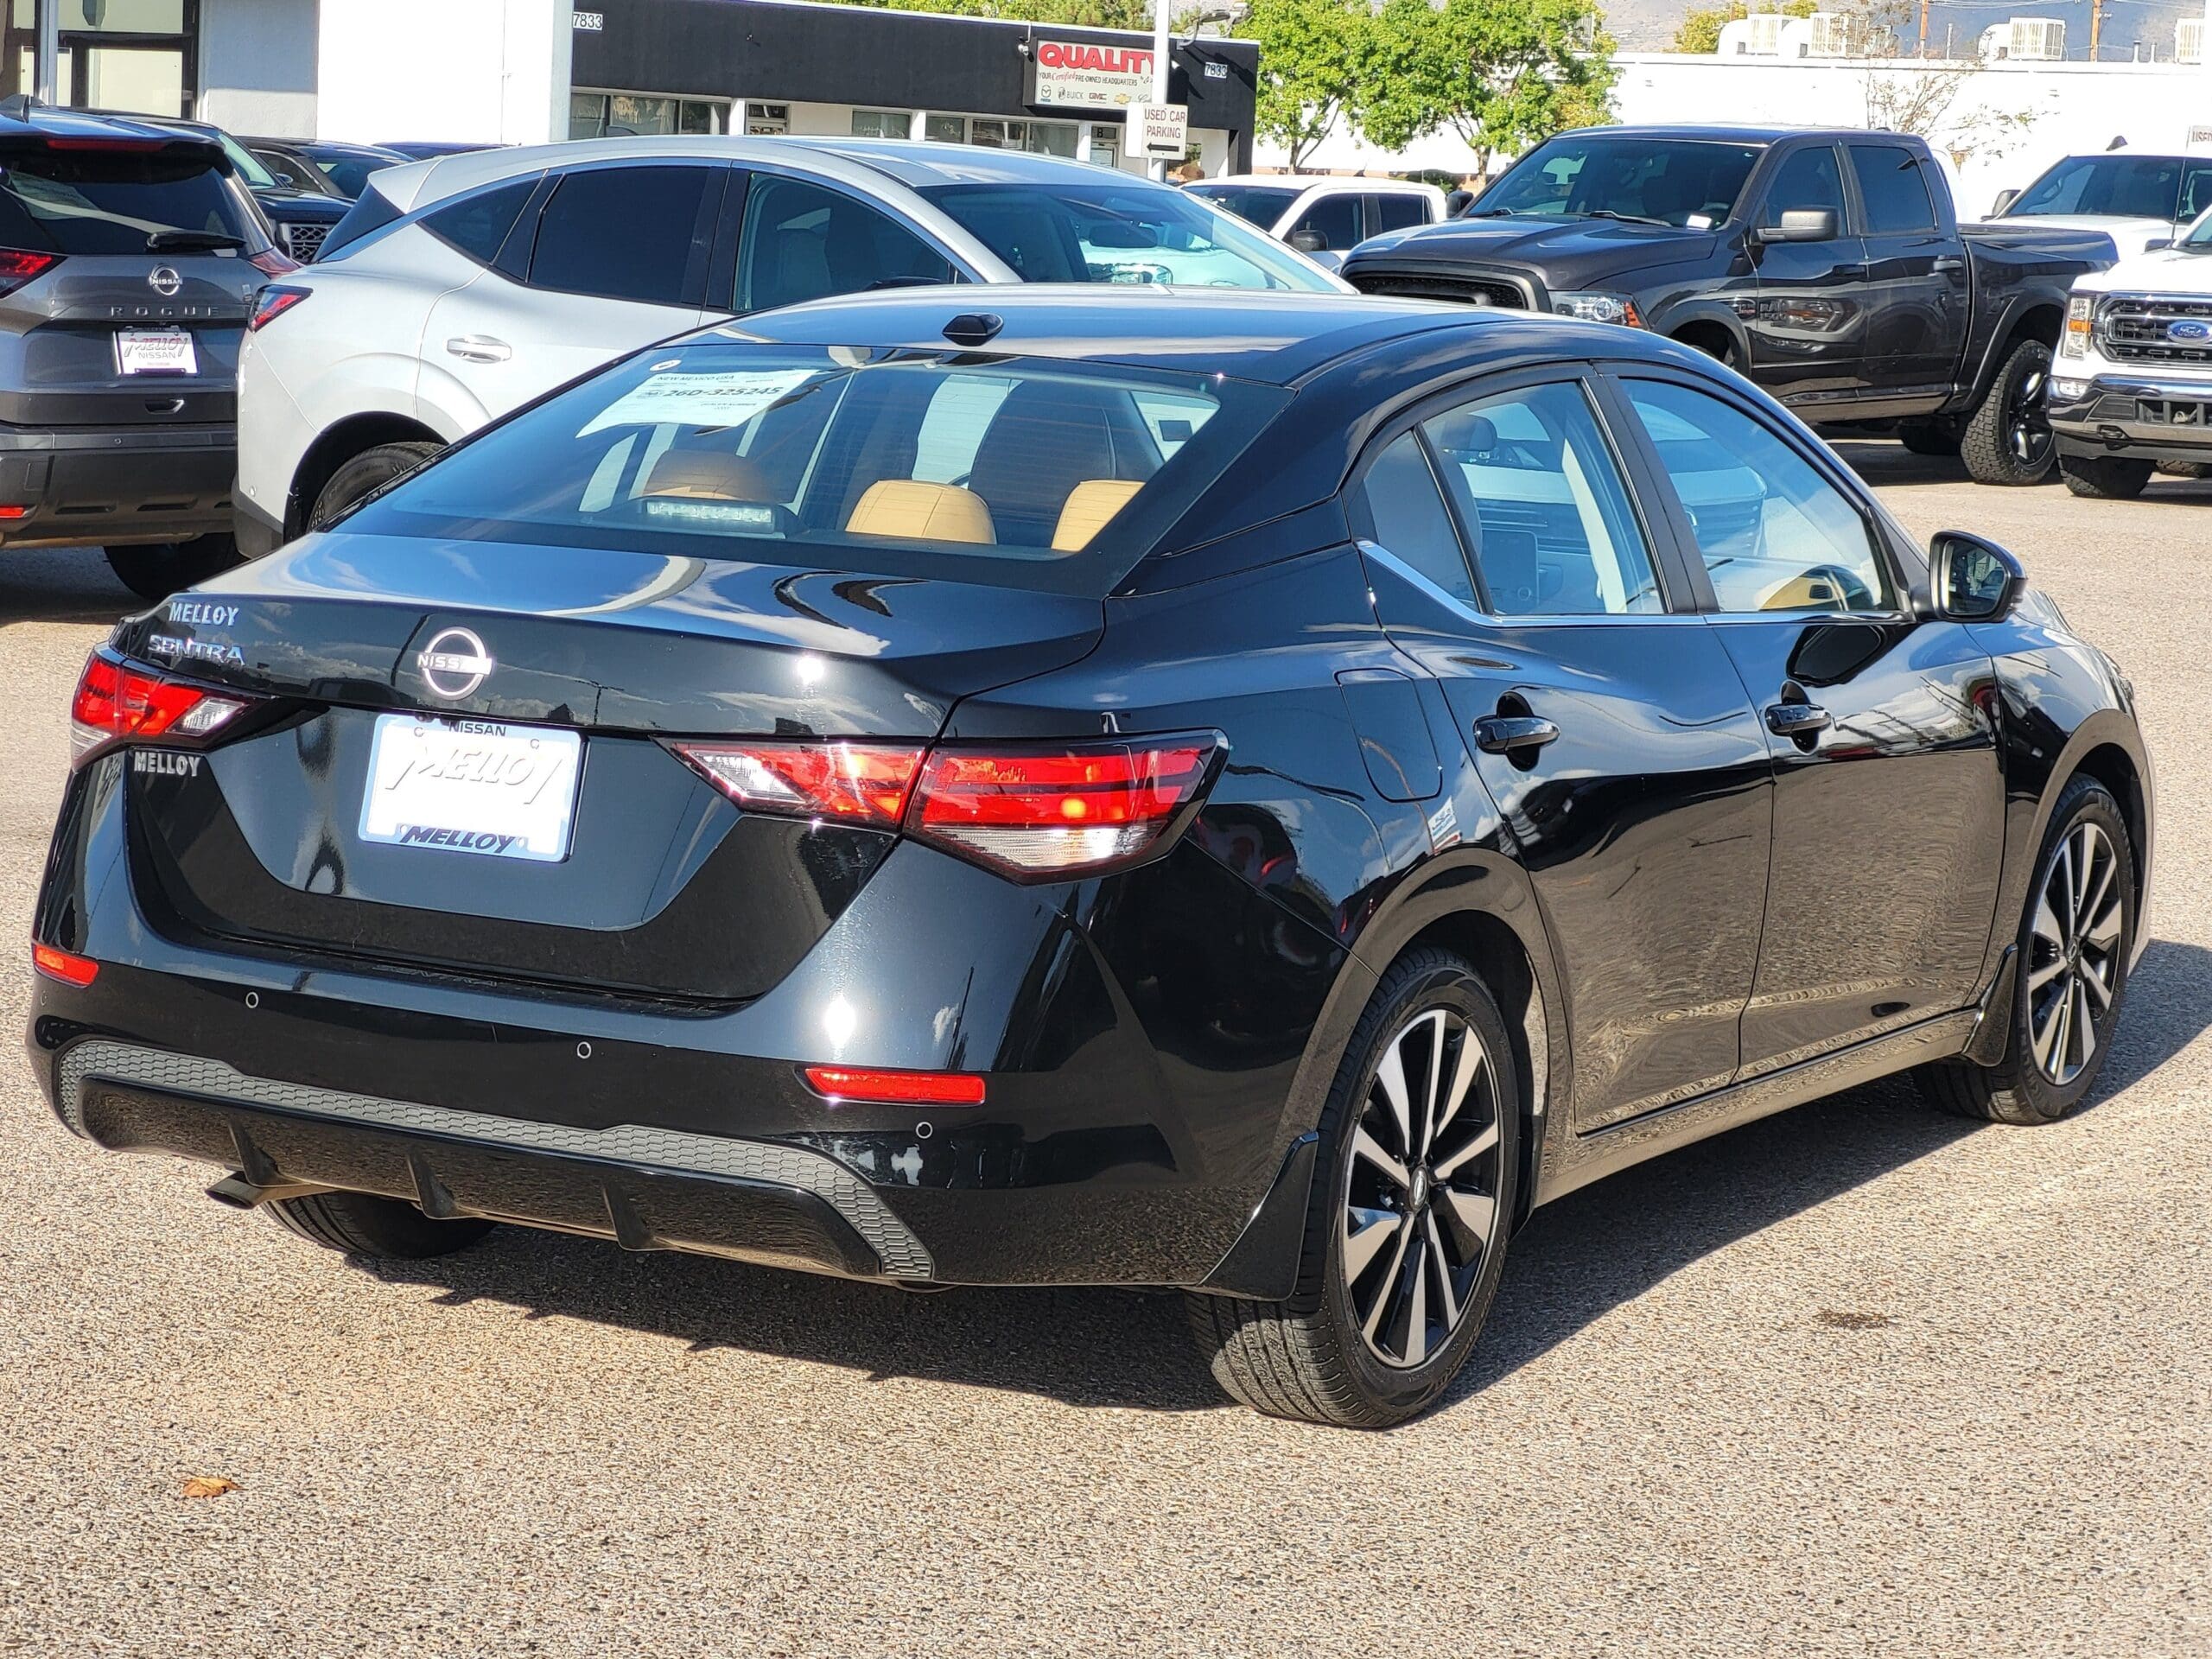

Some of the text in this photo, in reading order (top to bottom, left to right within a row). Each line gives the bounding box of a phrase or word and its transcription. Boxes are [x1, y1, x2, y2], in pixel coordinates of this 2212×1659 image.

[573, 13, 602, 29] 7833
[1205, 63, 1227, 77] 7833
[1052, 71, 1076, 82] Certified
[1075, 74, 1102, 84] PRE-OWNED
[1102, 75, 1138, 86] HEADQUARTERS
[1066, 91, 1084, 99] BUICK
[1144, 108, 1186, 122] USED CAR
[1147, 124, 1181, 139] PARKING
[111, 306, 219, 318] ROGUE
[124, 337, 188, 358] MELLOY
[138, 351, 176, 359] NISSAN
[168, 601, 239, 626] MELLOY
[148, 634, 245, 666] SENTRA
[448, 721, 506, 737] NISSAN
[134, 751, 201, 777] MELLOY
[401, 825, 518, 854] MELLOY
